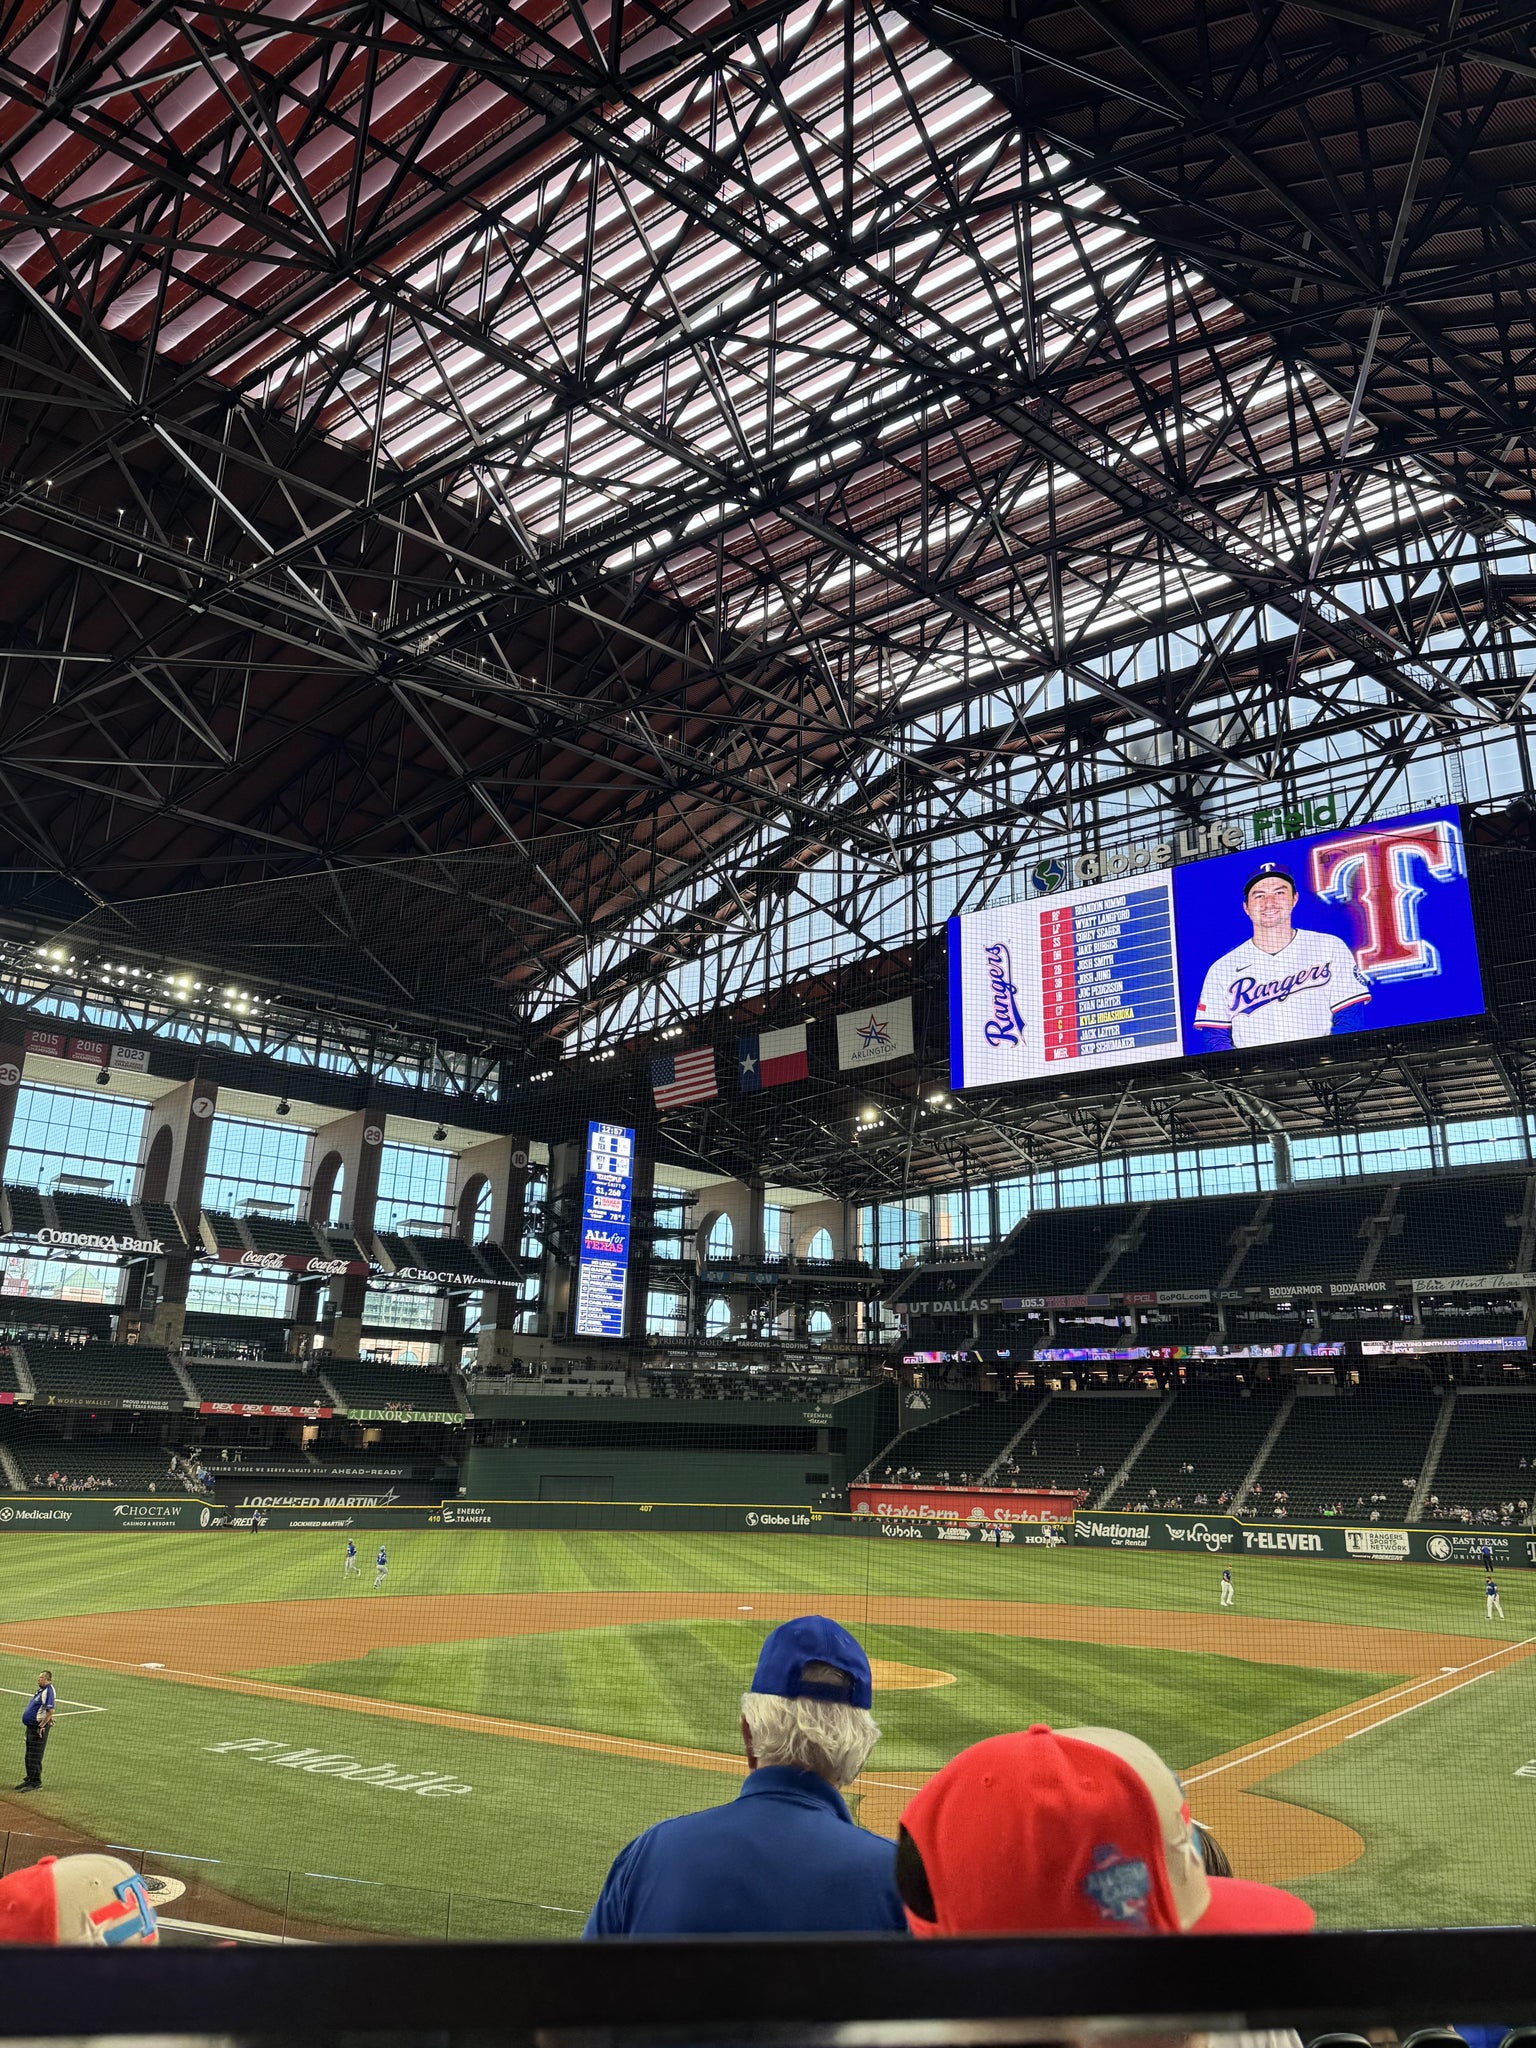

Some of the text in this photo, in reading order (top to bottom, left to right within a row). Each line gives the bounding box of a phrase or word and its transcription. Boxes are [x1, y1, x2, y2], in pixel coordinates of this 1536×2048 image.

[1074, 794, 1337, 882] Globe Life Field
[1053, 909, 1130, 934] LF WYATT LANGFORD
[1053, 925, 1121, 947] SS COREY SEAGER
[1077, 944, 1093, 956] JAKE
[1093, 939, 1118, 952] BURGER
[1077, 958, 1093, 970] JOSH
[1093, 954, 1114, 967] SMITH
[1078, 972, 1093, 984] JOSH
[1094, 969, 1111, 981] JUNG
[983, 941, 1026, 1048] Rangers
[1079, 981, 1123, 998] JOC PEDERSON
[1229, 961, 1332, 1014] Rangers
[1079, 1000, 1095, 1012] EVAN
[1096, 996, 1121, 1009] CARTER
[1080, 1014, 1096, 1026] KYLE
[31, 1031, 59, 1045] 2015
[1059, 1025, 1120, 1043] P JACK LEITER
[76, 1040, 102, 1053] 2016
[851, 1043, 897, 1060] ARLINGTON
[1081, 1037, 1135, 1055] SKIP SCHUMAKER
[117, 1047, 145, 1061] 2023
[200, 1102, 208, 1114] 7
[366, 1129, 381, 1142] 29
[121, 1236, 165, 1254] Bank
[585, 1229, 625, 1247] ALL for
[585, 1239, 623, 1253] TEXAS
[241, 1250, 287, 1268] Coca-Cola
[307, 1257, 350, 1274] Coca-Cola
[407, 1267, 474, 1284] CHOCTAW
[1269, 1285, 1322, 1296] BODYARMOR
[1330, 1282, 1386, 1293] BODYARMOR
[1415, 1279, 1445, 1291] Blue
[1448, 1277, 1487, 1289] Mint
[1159, 1293, 1207, 1302] GoPGL.com
[1221, 1291, 1242, 1299] PGL
[910, 1300, 988, 1313] UT DALLAS
[1021, 1298, 1045, 1308] 105.3
[212, 1402, 234, 1410] DEX
[300, 1406, 320, 1414] DEX
[360, 1410, 463, 1423] LUXOR STAFFING
[243, 1497, 378, 1507] LOCKHEED MARTIN
[16, 1510, 72, 1522] Medical City
[117, 1504, 182, 1516] CHOCTAW
[877, 1503, 959, 1525] State Farm
[993, 1508, 1038, 1526] State
[760, 1514, 810, 1525] Globe Life
[882, 1524, 922, 1538] Kubota
[1091, 1522, 1150, 1539] National
[1187, 1522, 1233, 1552] Kroger
[1125, 1539, 1147, 1547] Rental
[1348, 1532, 1363, 1549] T
[1453, 1537, 1508, 1546] EAST TEXAS
